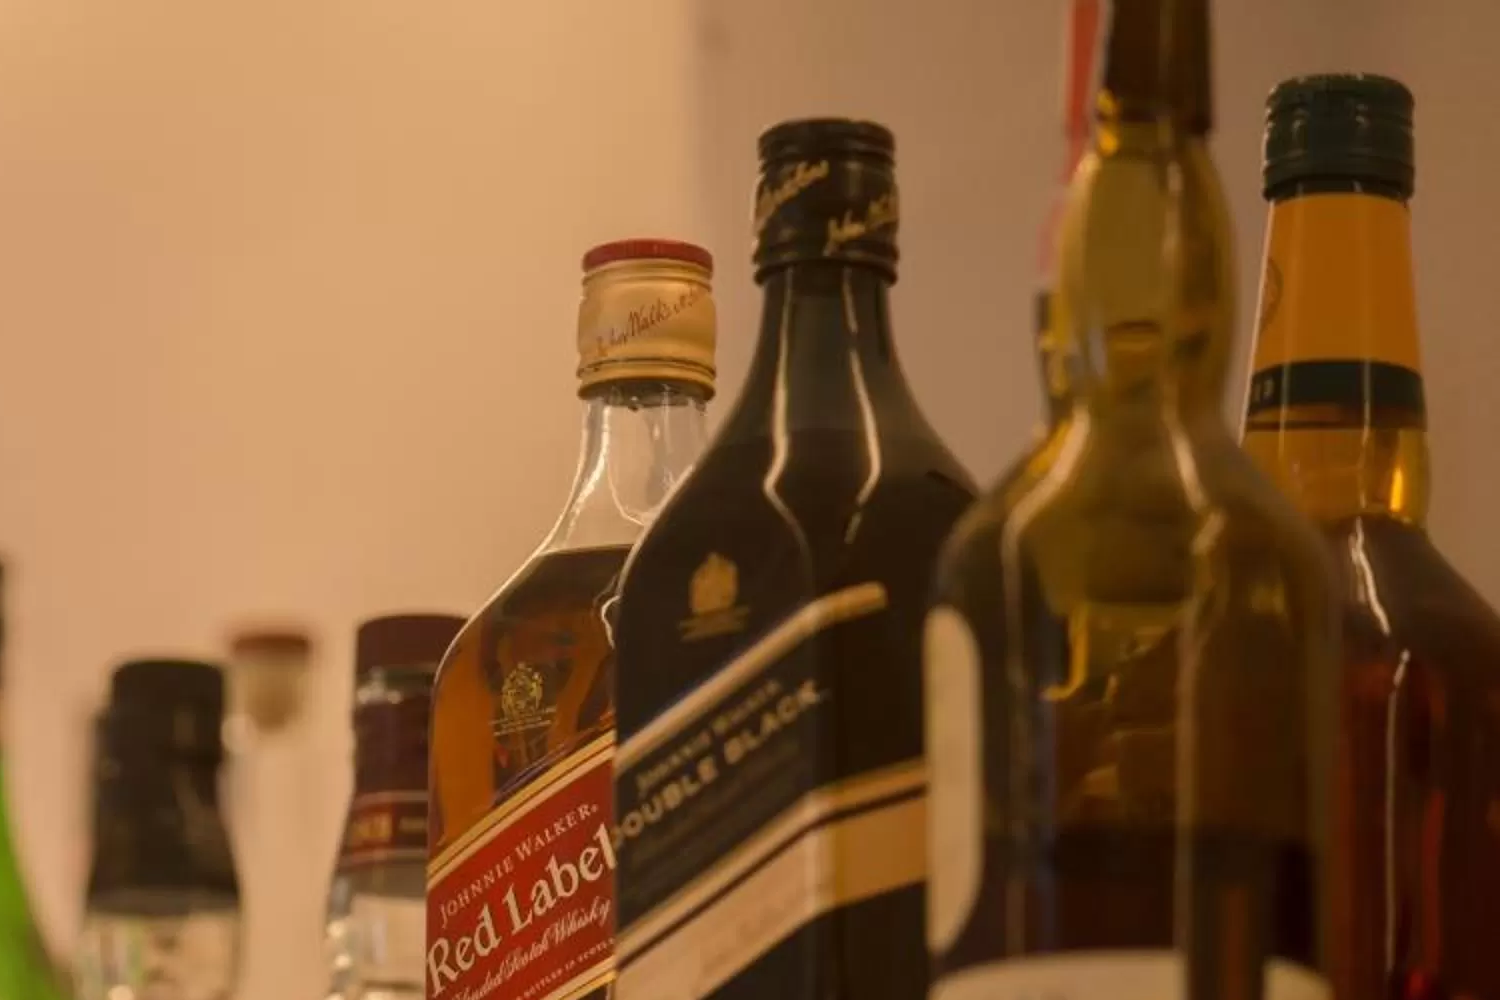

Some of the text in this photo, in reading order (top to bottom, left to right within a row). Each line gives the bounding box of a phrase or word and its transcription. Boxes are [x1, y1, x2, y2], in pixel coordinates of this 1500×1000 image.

[723, 678, 826, 765] BLACK
[426, 903, 502, 998] Red
[502, 821, 618, 936] Label
[439, 854, 516, 930] JOHNNIE
[550, 895, 612, 948] Whisky
